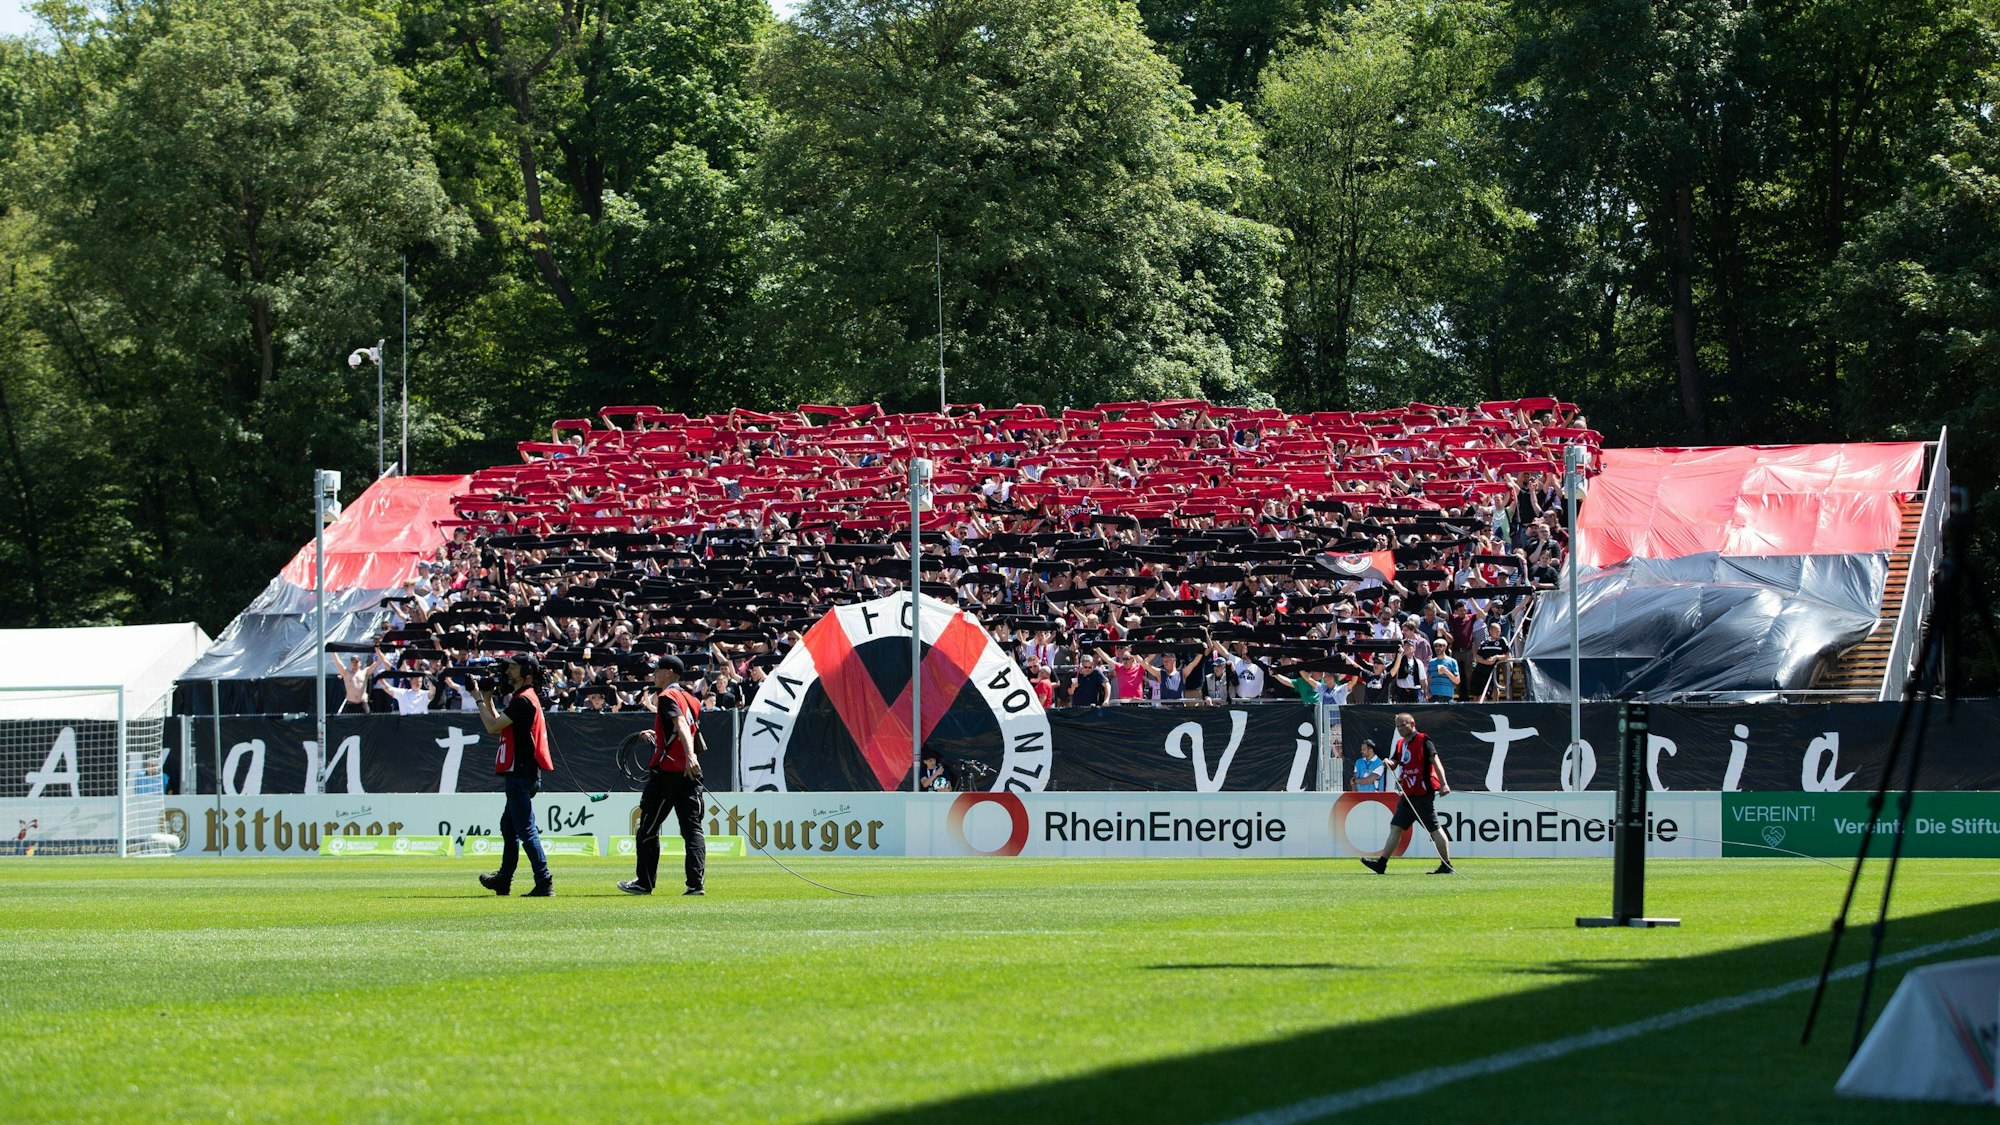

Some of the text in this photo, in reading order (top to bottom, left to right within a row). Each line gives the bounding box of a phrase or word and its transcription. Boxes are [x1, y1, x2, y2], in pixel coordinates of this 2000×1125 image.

[988, 667, 1030, 713] 04
[1164, 710, 1856, 793] Vitoria
[548, 805, 594, 832] Bit
[708, 805, 885, 852] itburger
[1045, 811, 1286, 849] RheinEnergie
[1430, 811, 1679, 843] RheinEnerie
[1732, 806, 1816, 822] VEREINT!
[1915, 818, 1947, 834] Die
